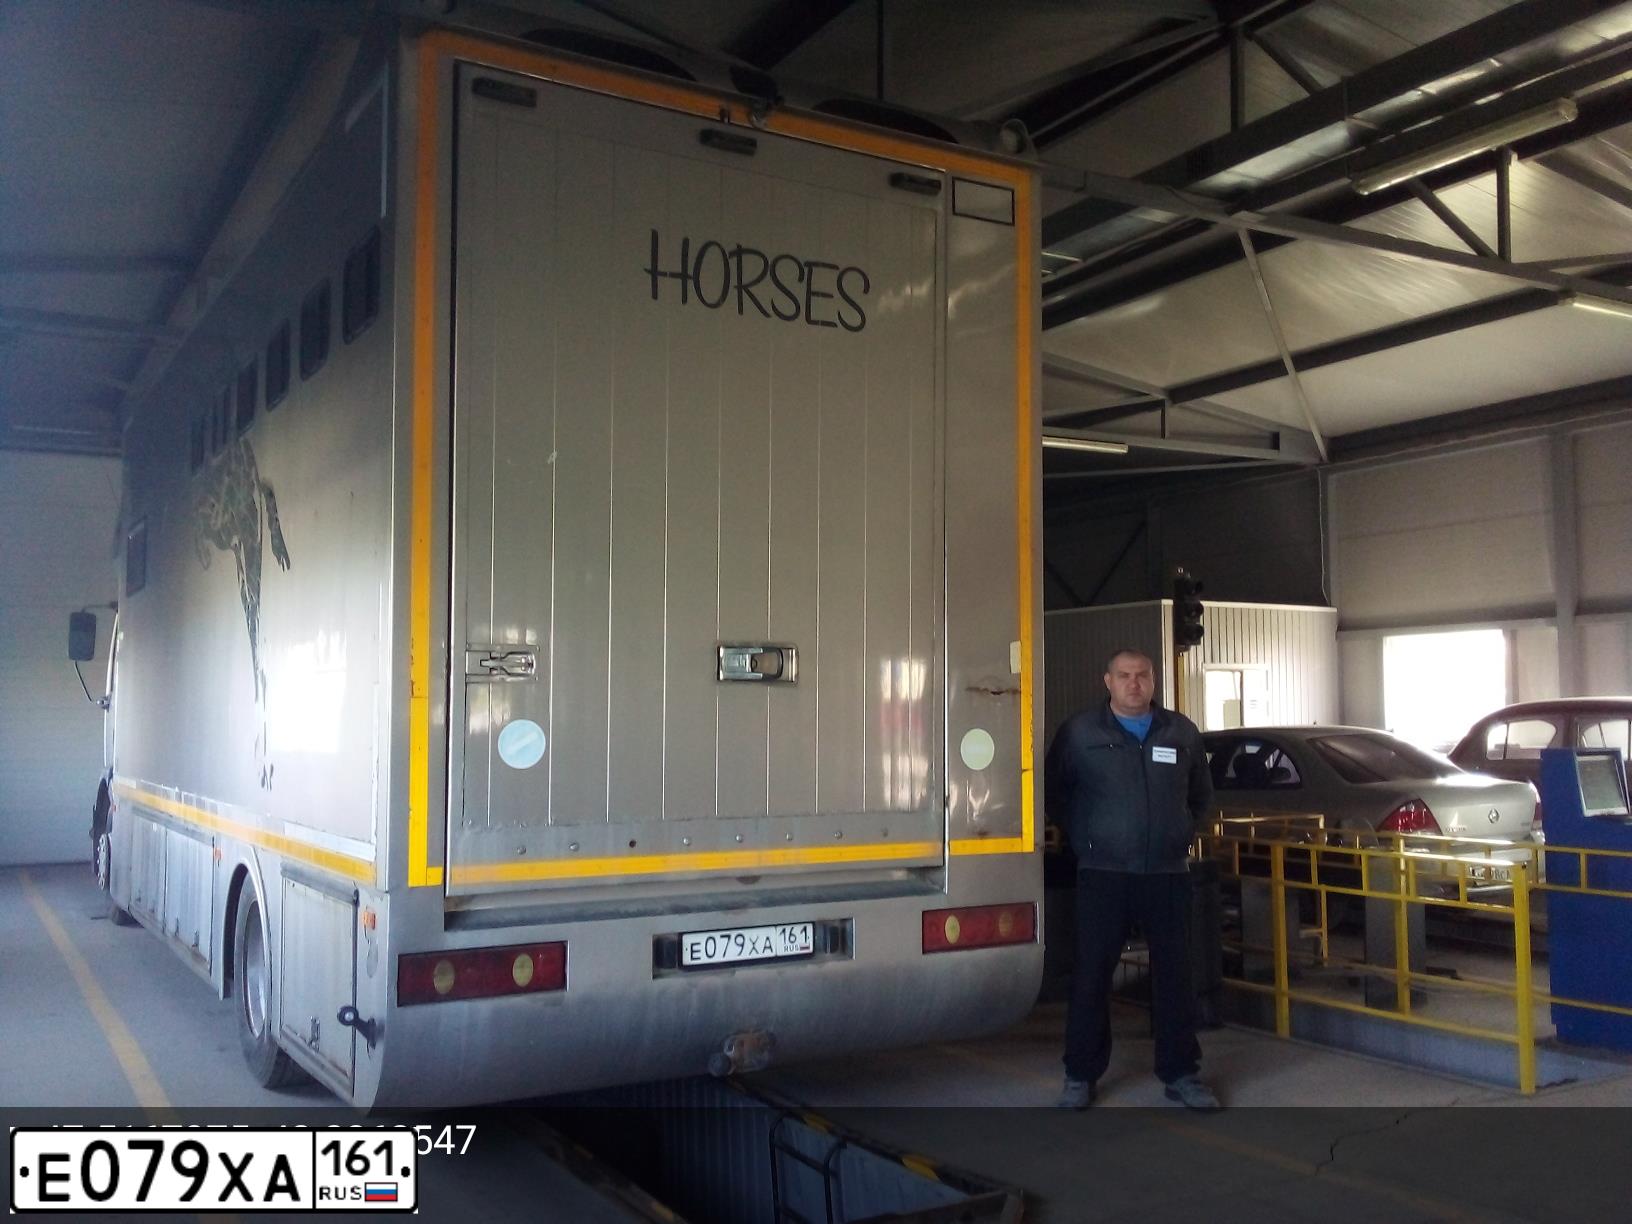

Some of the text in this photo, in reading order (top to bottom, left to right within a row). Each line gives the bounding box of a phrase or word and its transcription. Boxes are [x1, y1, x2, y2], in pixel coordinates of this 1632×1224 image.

[643, 228, 870, 332] HORSES
[690, 925, 808, 962] E079XA 161
[784, 944, 800, 953] RUS
